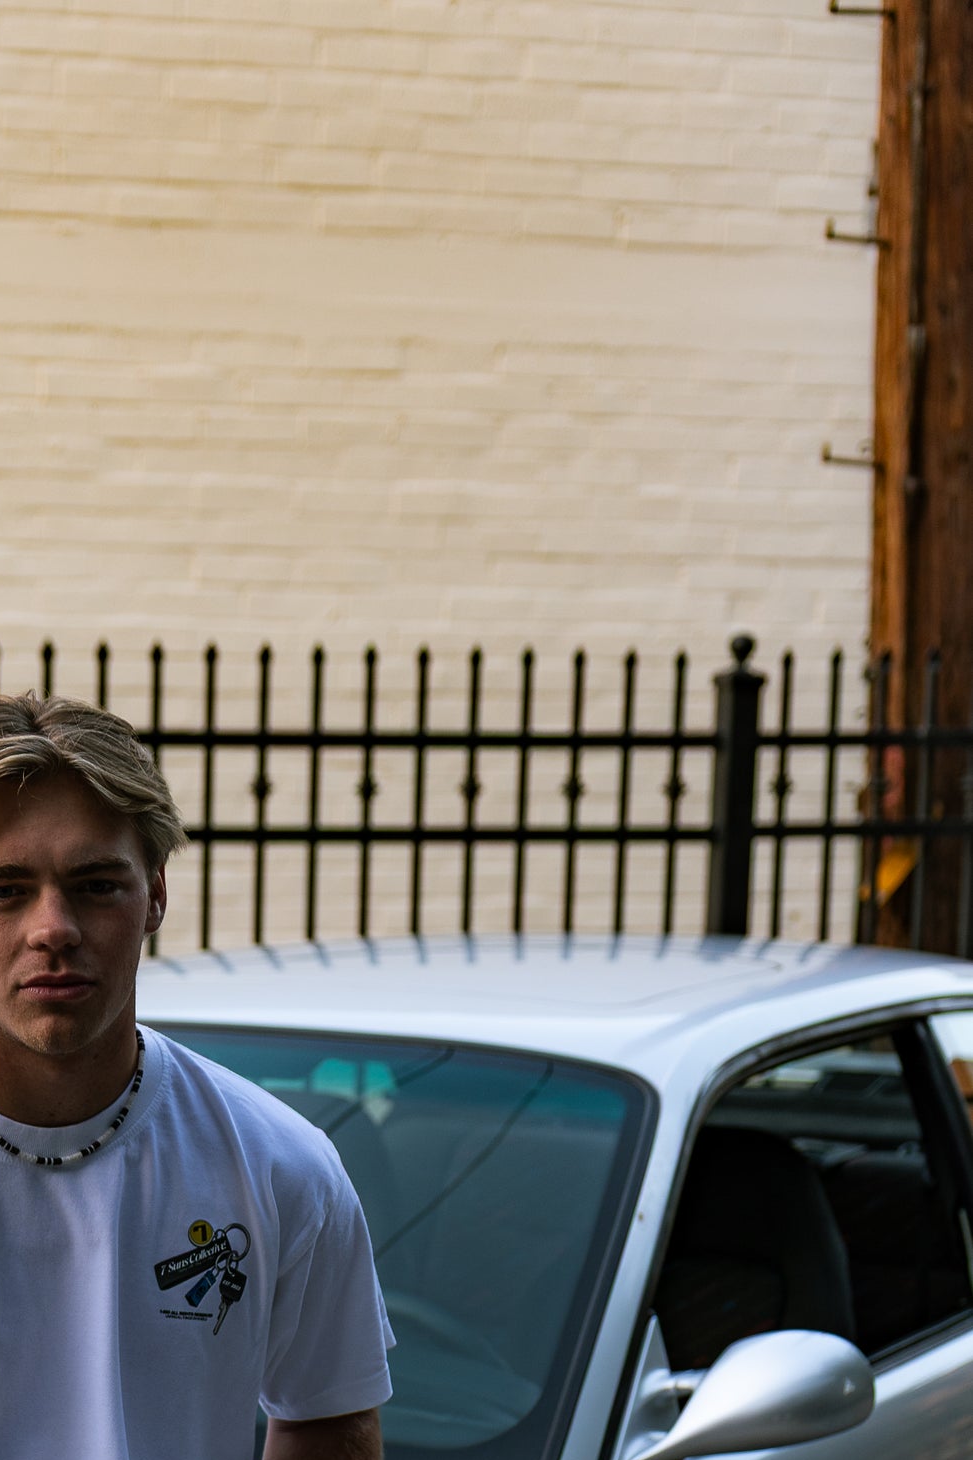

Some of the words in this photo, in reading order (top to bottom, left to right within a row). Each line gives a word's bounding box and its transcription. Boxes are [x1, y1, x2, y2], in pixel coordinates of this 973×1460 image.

[193, 1224, 207, 1242] 7
[160, 1264, 167, 1276] 7
[168, 1258, 189, 1273] Suns
